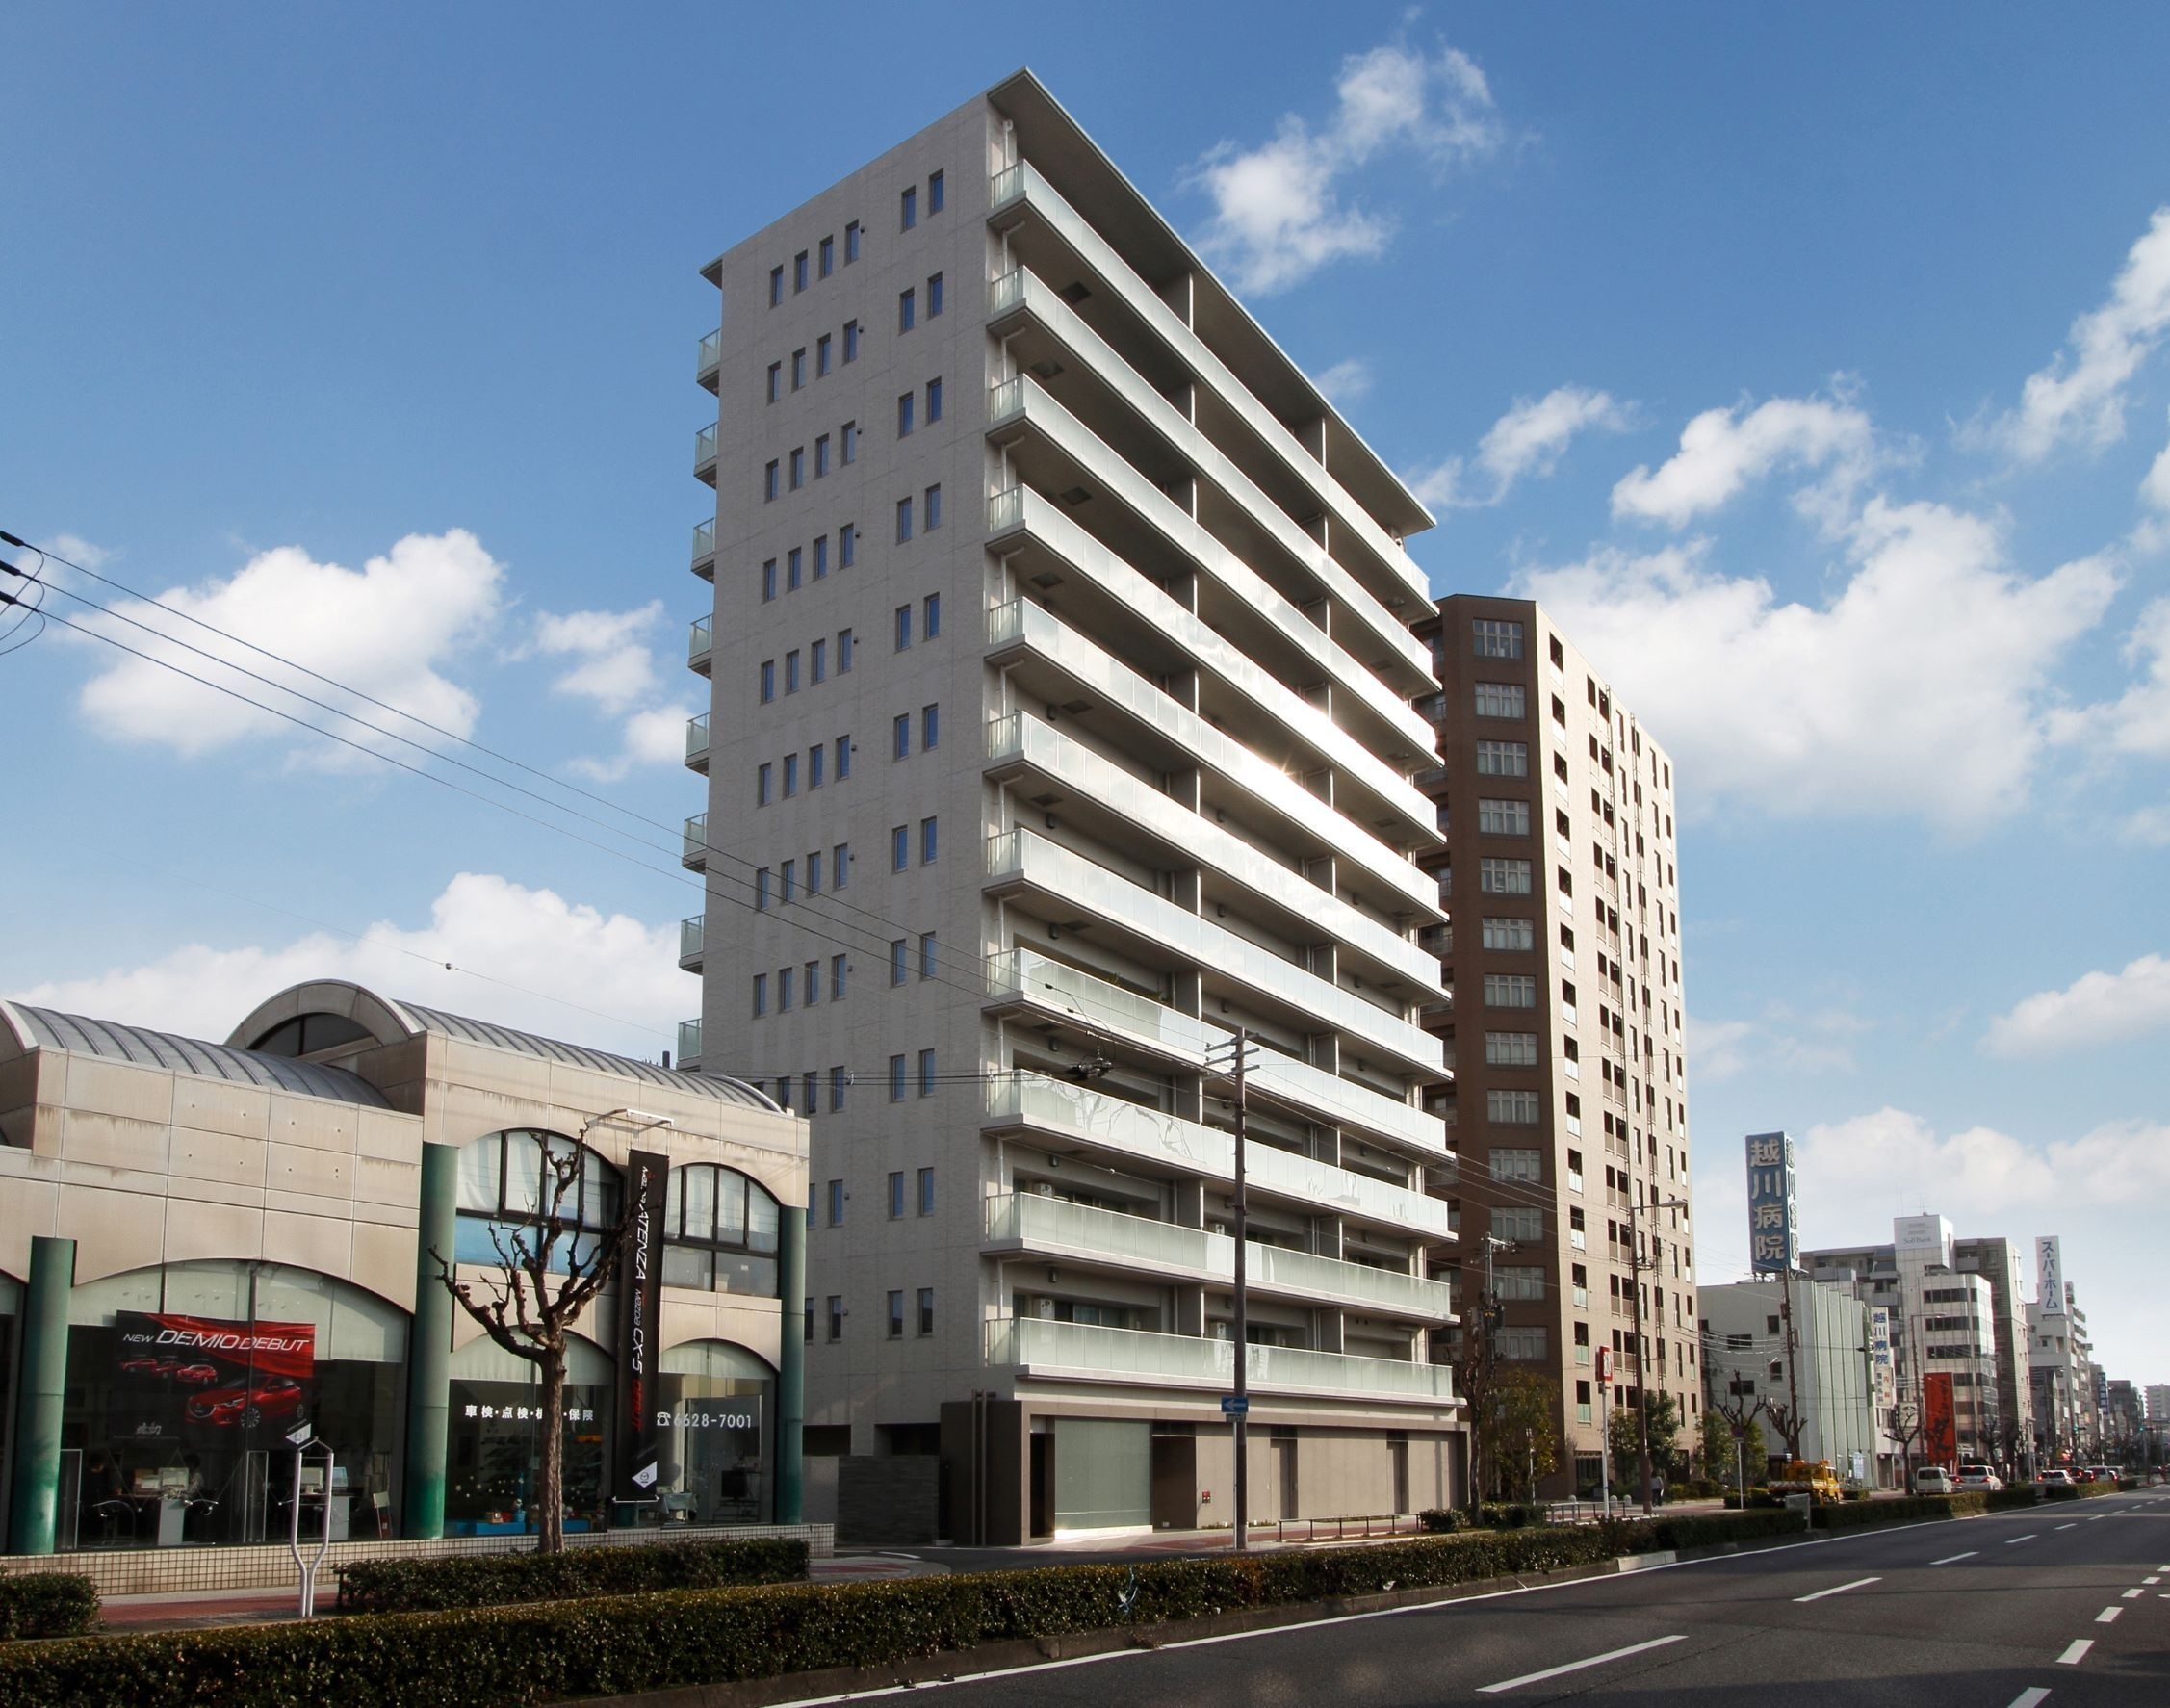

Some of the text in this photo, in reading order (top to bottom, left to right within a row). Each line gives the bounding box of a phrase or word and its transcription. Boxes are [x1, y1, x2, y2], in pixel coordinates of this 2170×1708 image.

[1750, 1138, 1785, 1261] 越川病院
[635, 1204, 650, 1280] ATENZA
[2042, 1241, 2058, 1309] スーパーホーム
[122, 1329, 310, 1352] NEW DEMIO DEBUT
[632, 1328, 644, 1374] CX-5
[673, 1413, 751, 1429] 6628-7001
